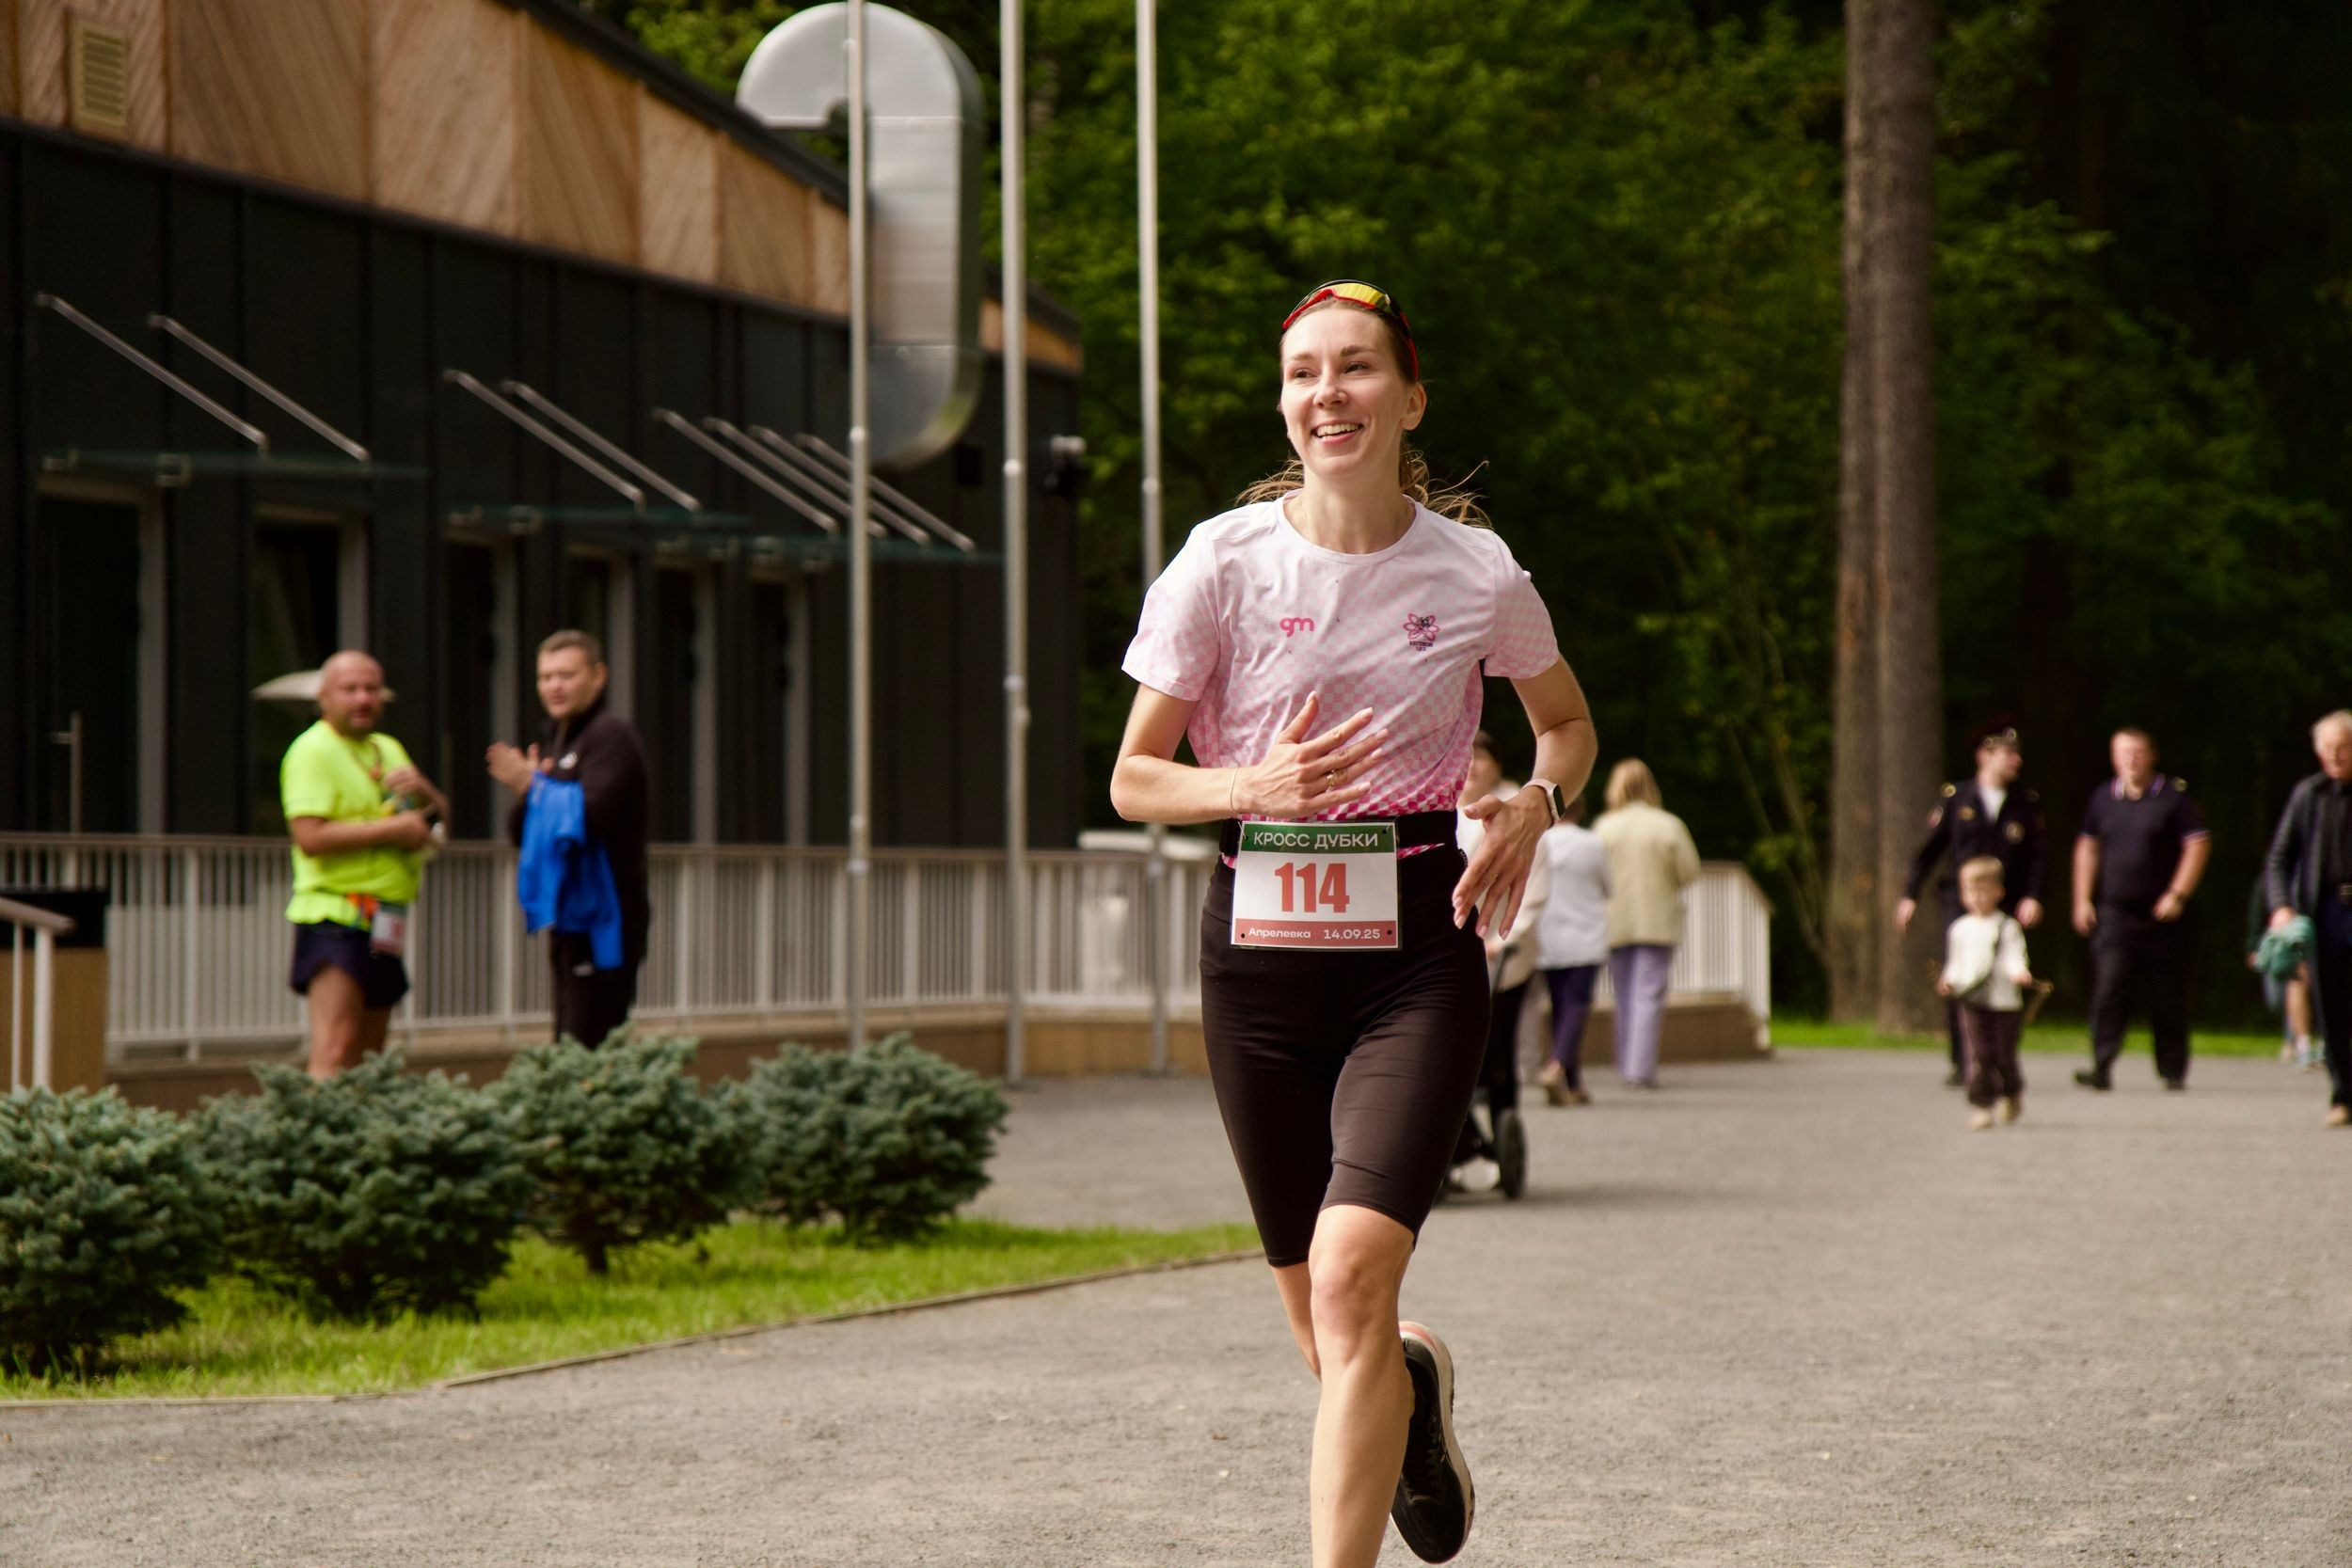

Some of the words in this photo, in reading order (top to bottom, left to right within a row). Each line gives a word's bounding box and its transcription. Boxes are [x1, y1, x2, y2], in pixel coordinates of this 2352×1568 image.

[1253, 832, 1311, 847] КРОСС
[1314, 833, 1378, 849] ДУБКИ
[1274, 863, 1350, 913] 114
[1248, 927, 1311, 939] Апрелевка
[1324, 928, 1381, 940] 14.09.25
